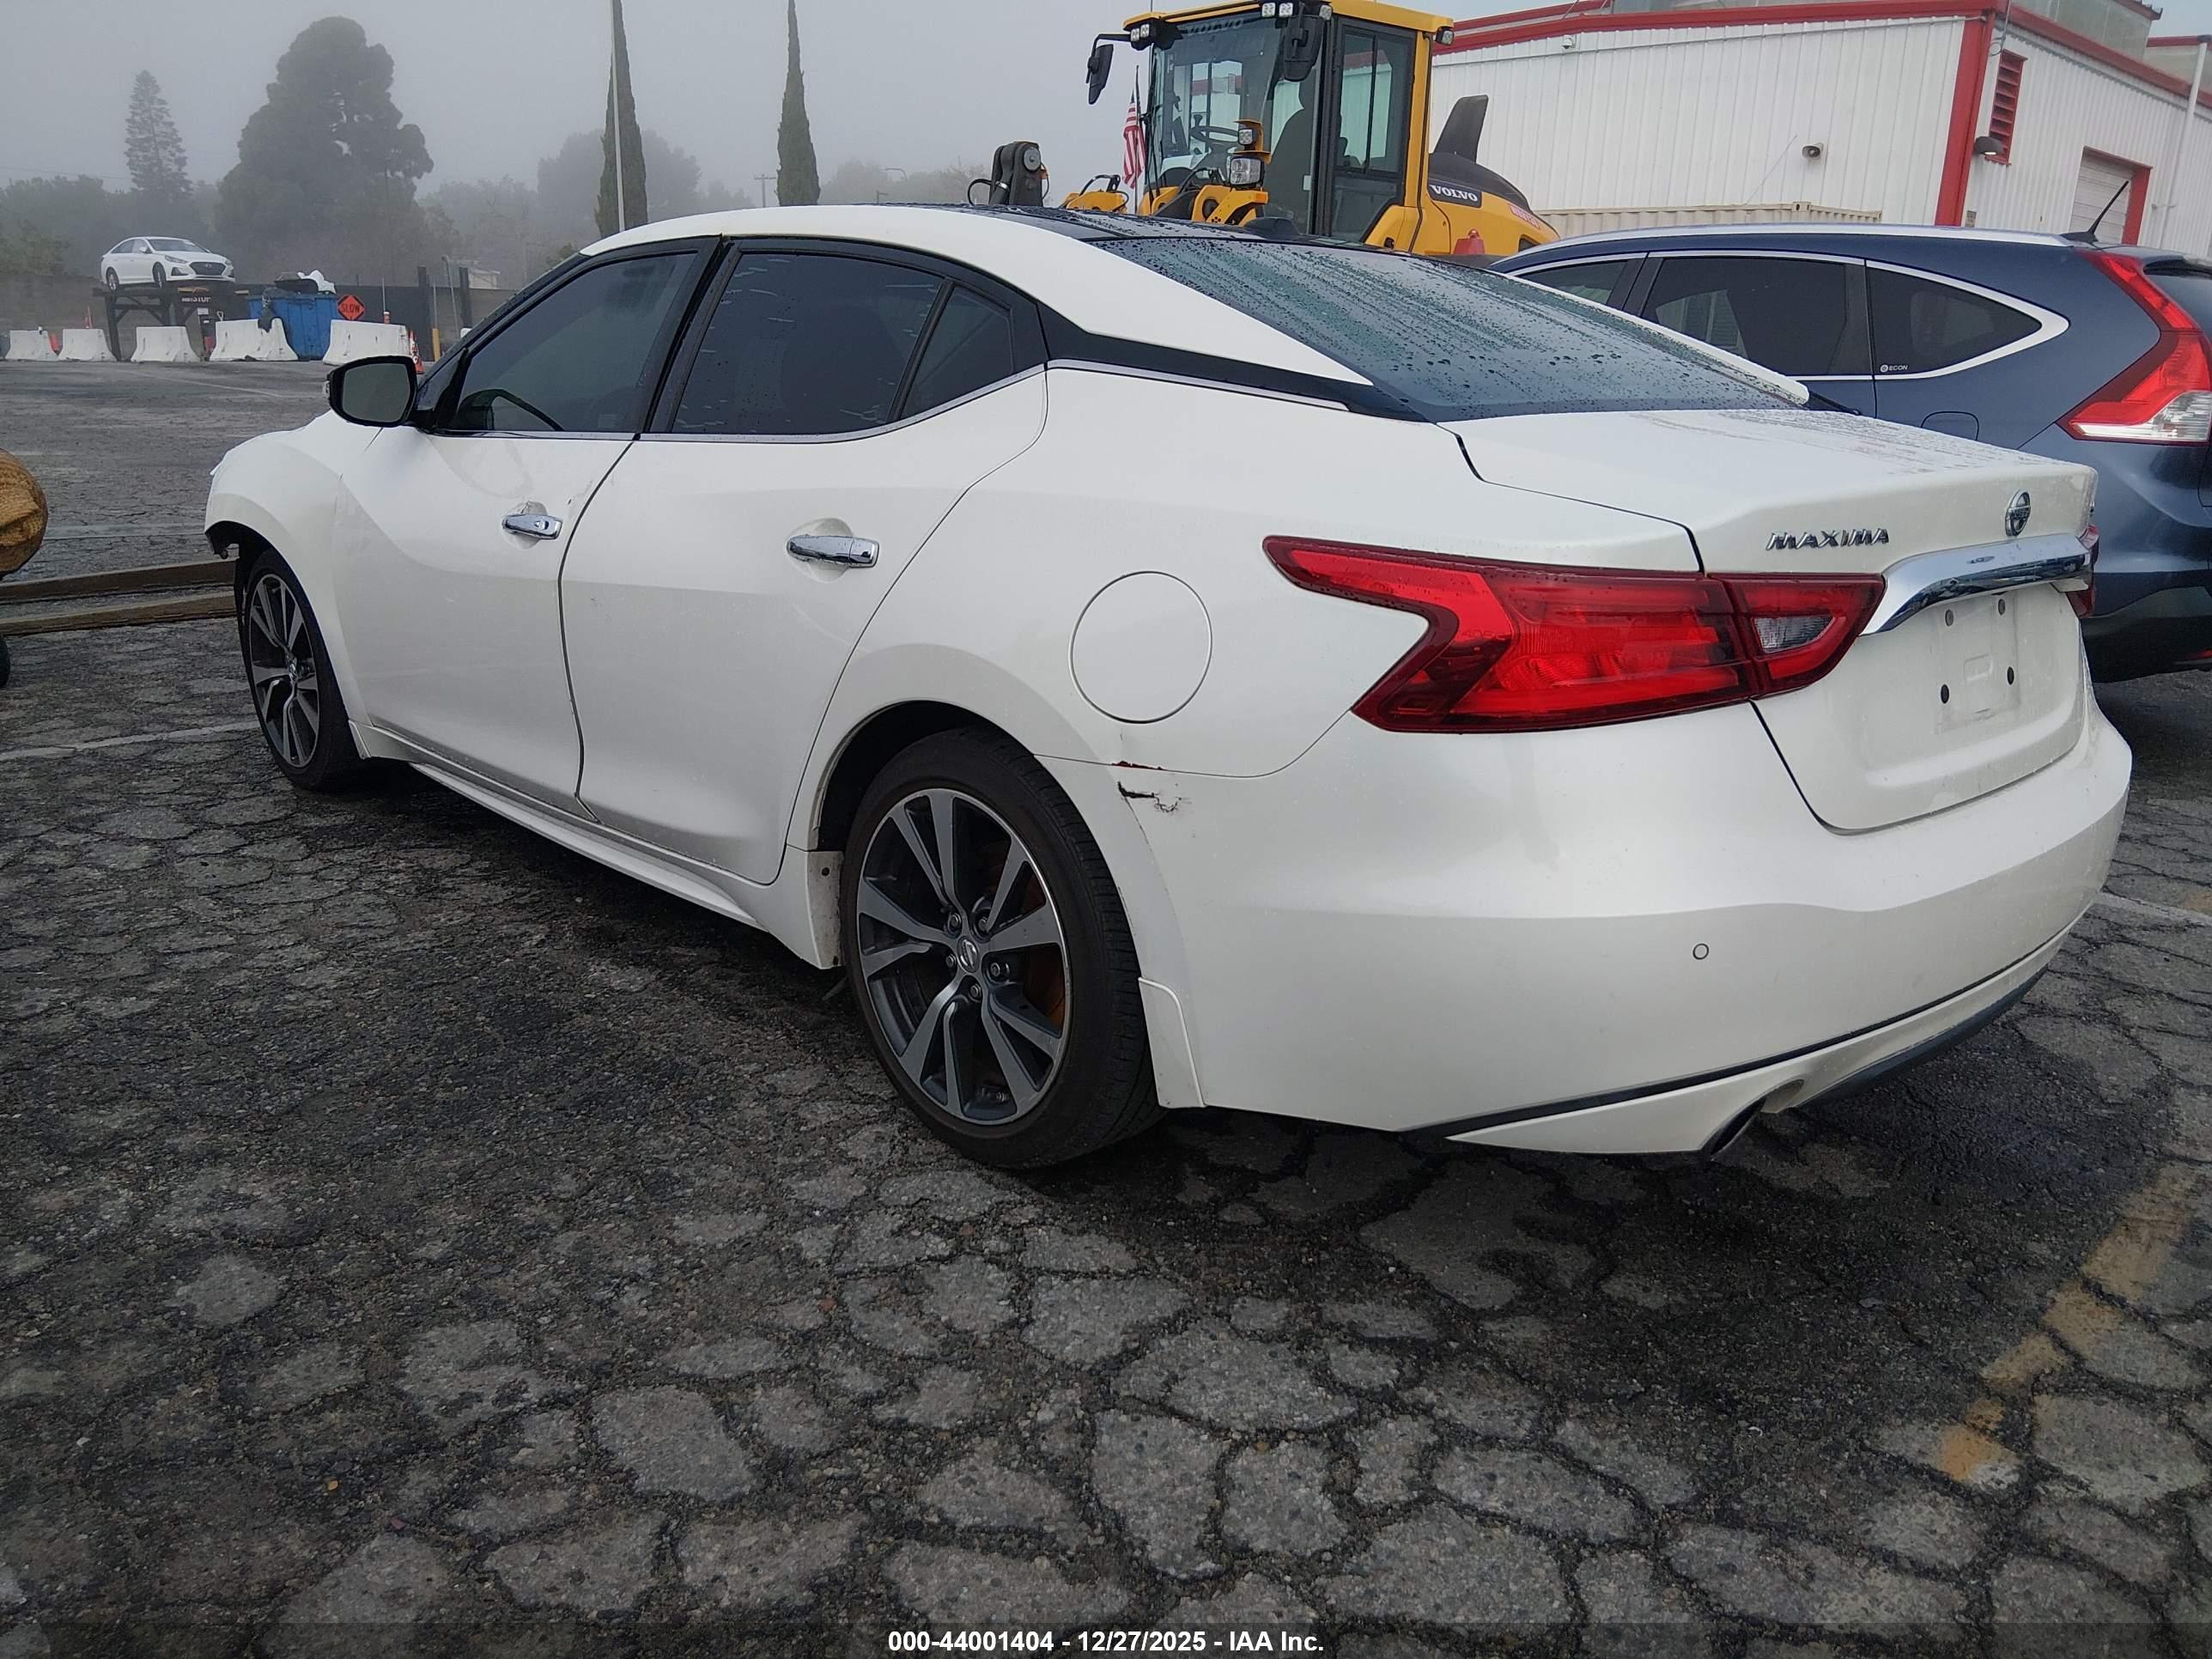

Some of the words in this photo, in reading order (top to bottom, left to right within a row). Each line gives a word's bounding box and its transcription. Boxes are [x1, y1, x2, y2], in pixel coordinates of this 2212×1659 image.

[1428, 184, 1478, 202] VOLVO
[341, 302, 361, 313] SLOW
[1765, 527, 1890, 551] MAXIMA
